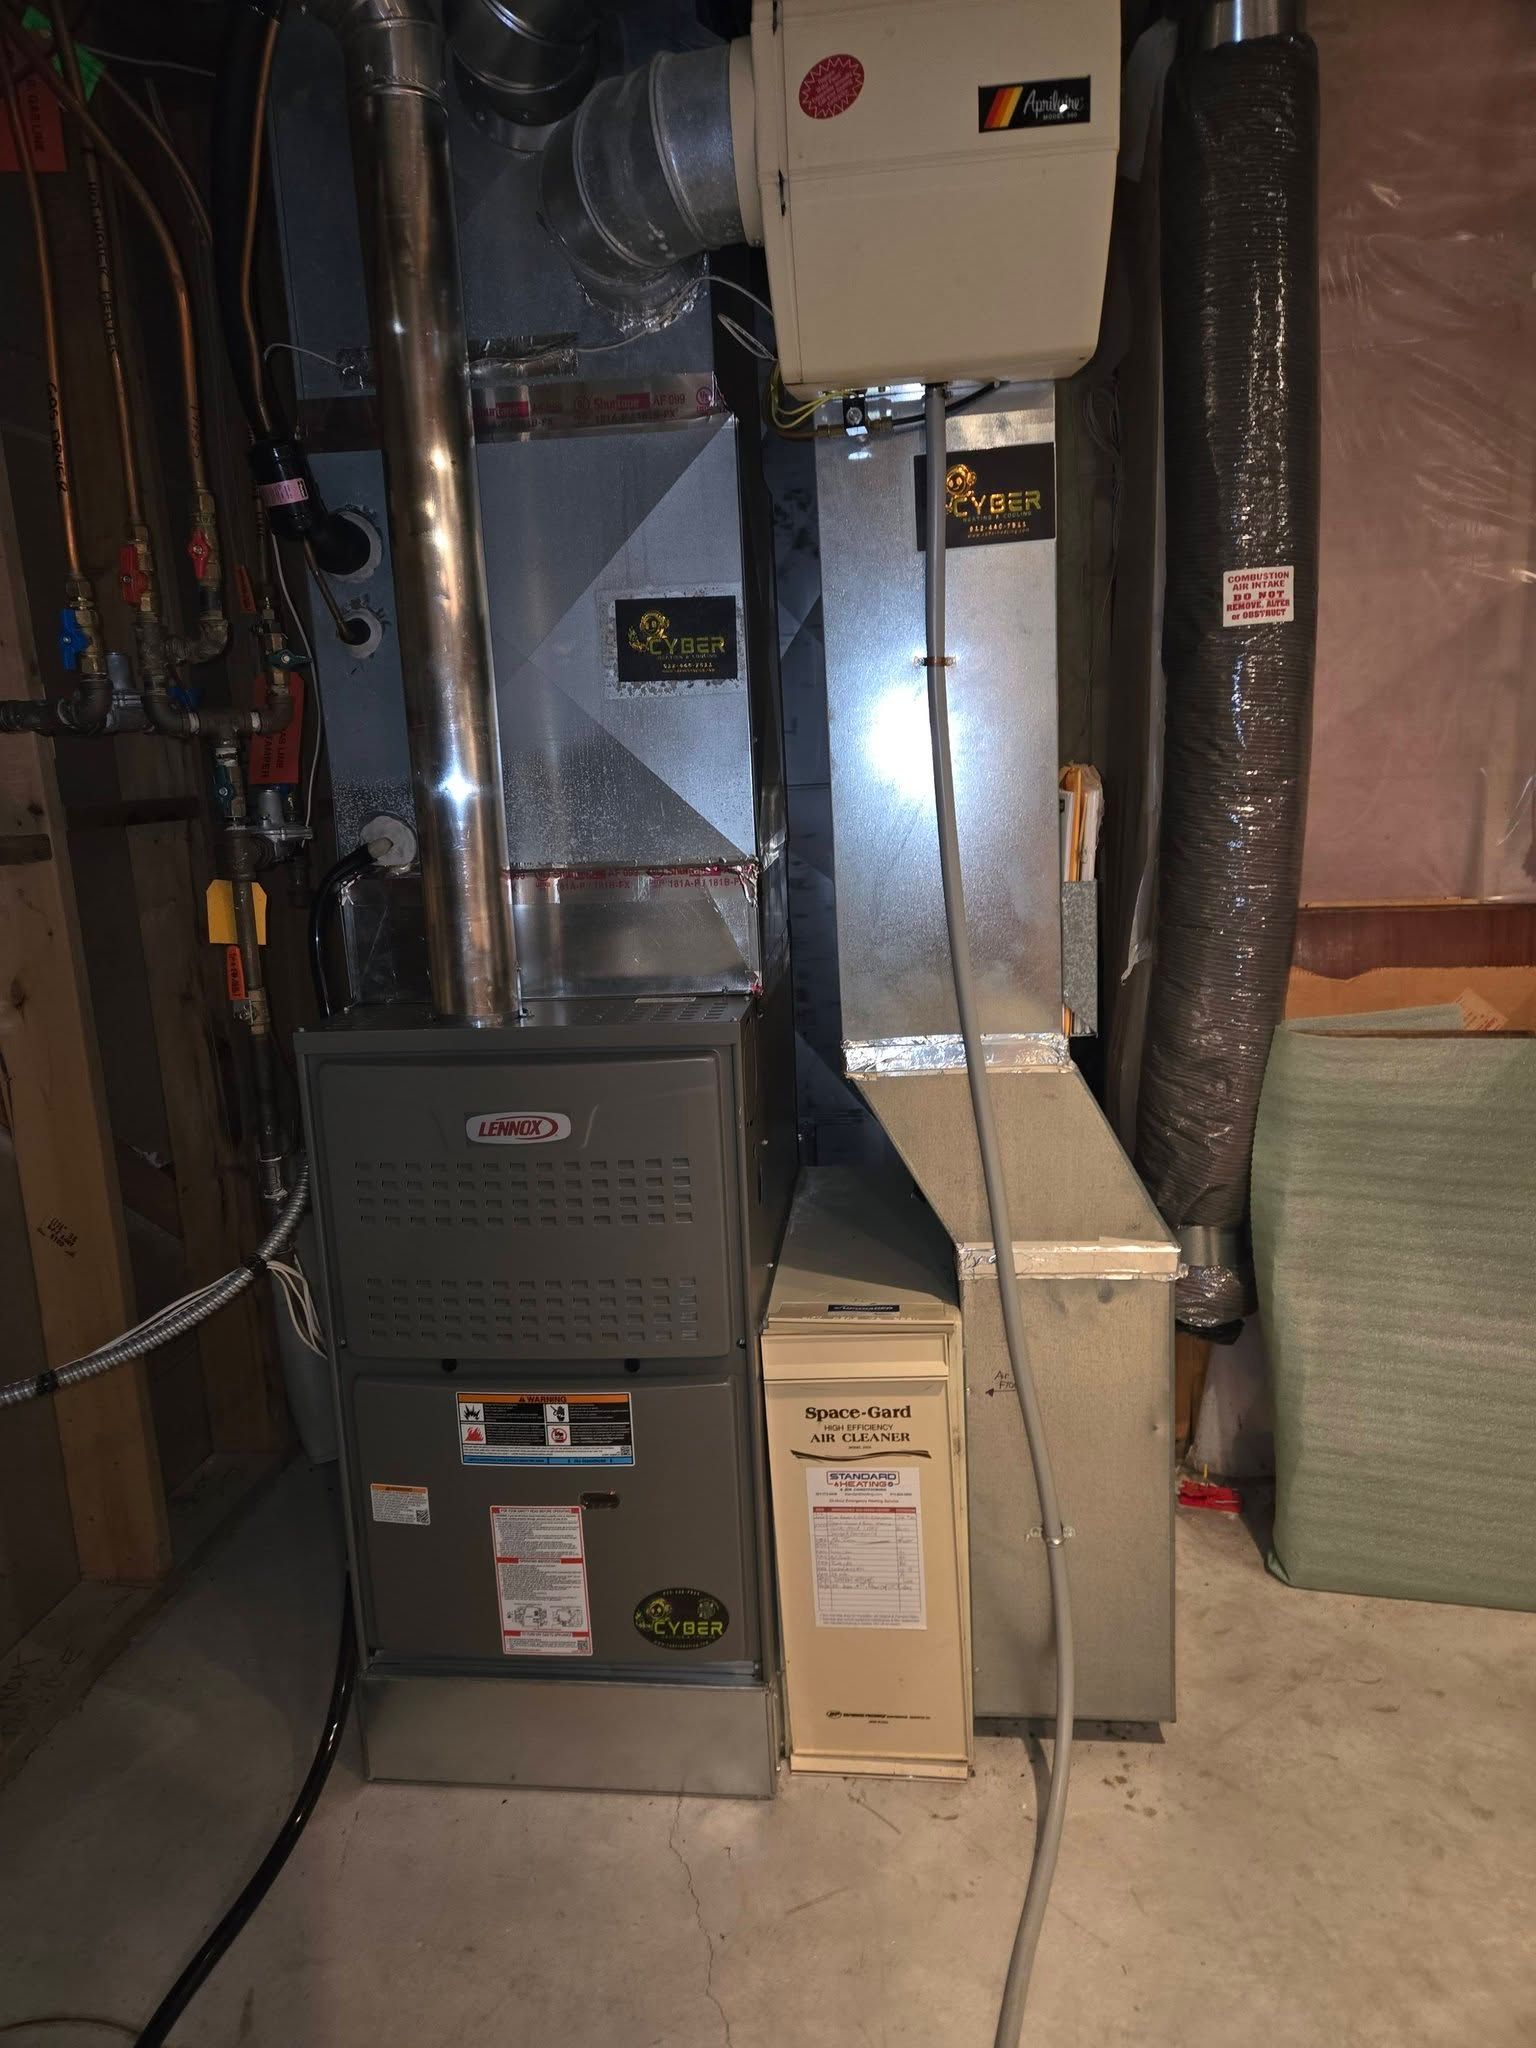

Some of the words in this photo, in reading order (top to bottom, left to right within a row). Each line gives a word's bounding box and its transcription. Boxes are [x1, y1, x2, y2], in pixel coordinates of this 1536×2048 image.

[953, 490, 1041, 518] CYBER
[1003, 511, 1032, 519] COOLING
[1228, 571, 1289, 583] COMBUSTION
[1232, 583, 1249, 591] AIR
[1251, 580, 1285, 589] INTAKE
[1233, 593, 1251, 601] DO
[1258, 590, 1284, 599] NOT
[1226, 601, 1264, 612] REMOVE,
[1266, 599, 1290, 608] ALTER
[1242, 608, 1286, 619] OBSTRUCT
[649, 636, 726, 656] CYBER
[478, 1119, 543, 1137] LENNOX
[805, 1405, 911, 1422] Space-Gard
[810, 1433, 835, 1443] AIR
[842, 1432, 910, 1443] CLEANER
[654, 1621, 723, 1635] CYBER
